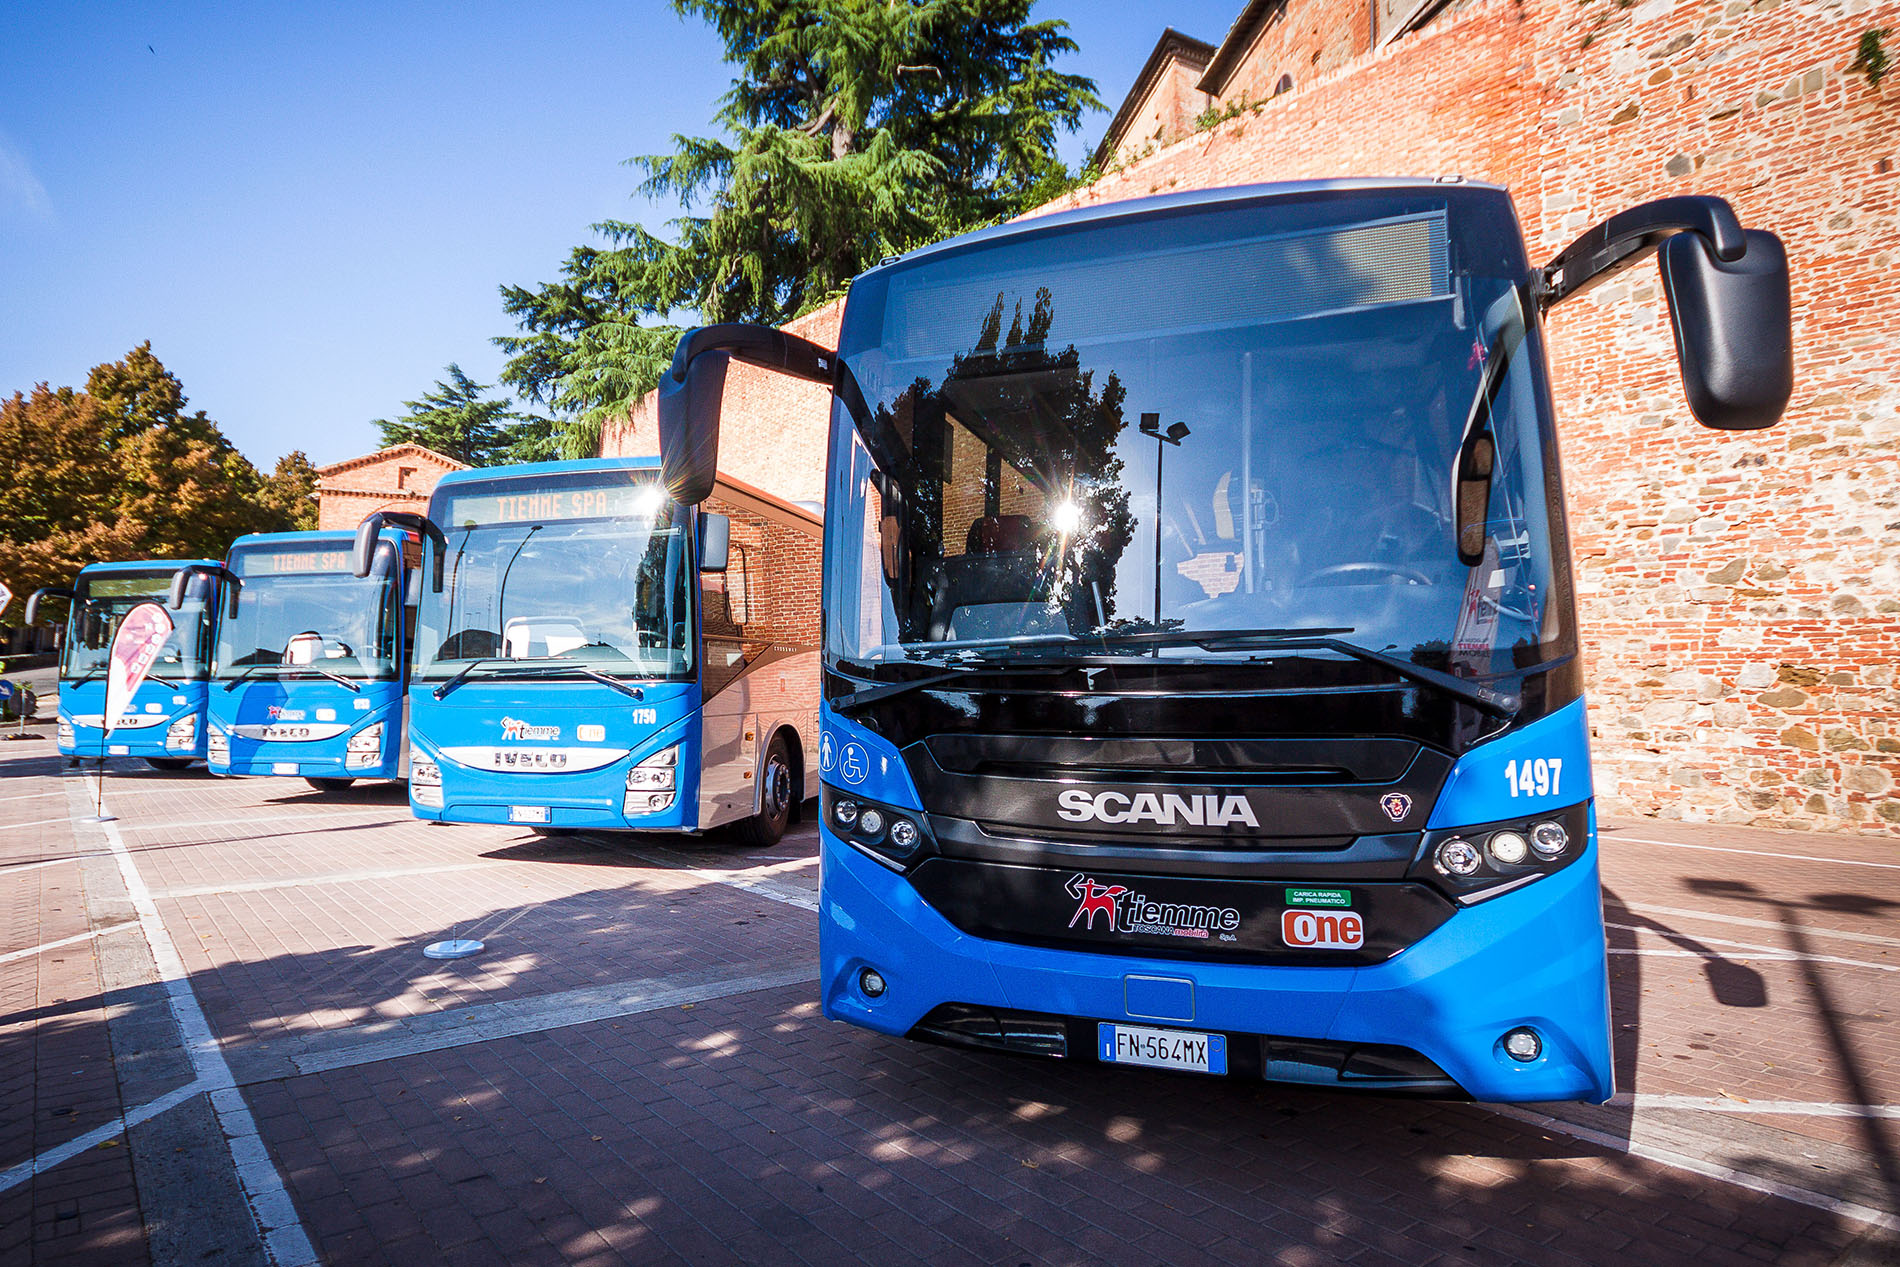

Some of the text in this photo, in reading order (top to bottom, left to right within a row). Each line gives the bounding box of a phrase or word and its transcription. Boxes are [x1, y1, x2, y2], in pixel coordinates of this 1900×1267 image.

[497, 491, 608, 520] TIEMME SPA
[273, 552, 346, 573] TIEMME SPA
[632, 708, 657, 725] 1750
[262, 727, 310, 737] IVECO
[494, 751, 567, 768] IVECO
[1504, 757, 1563, 798] 1497
[1056, 789, 1261, 828] SCANIA
[1117, 890, 1241, 934] tiemme
[1283, 911, 1362, 946] One
